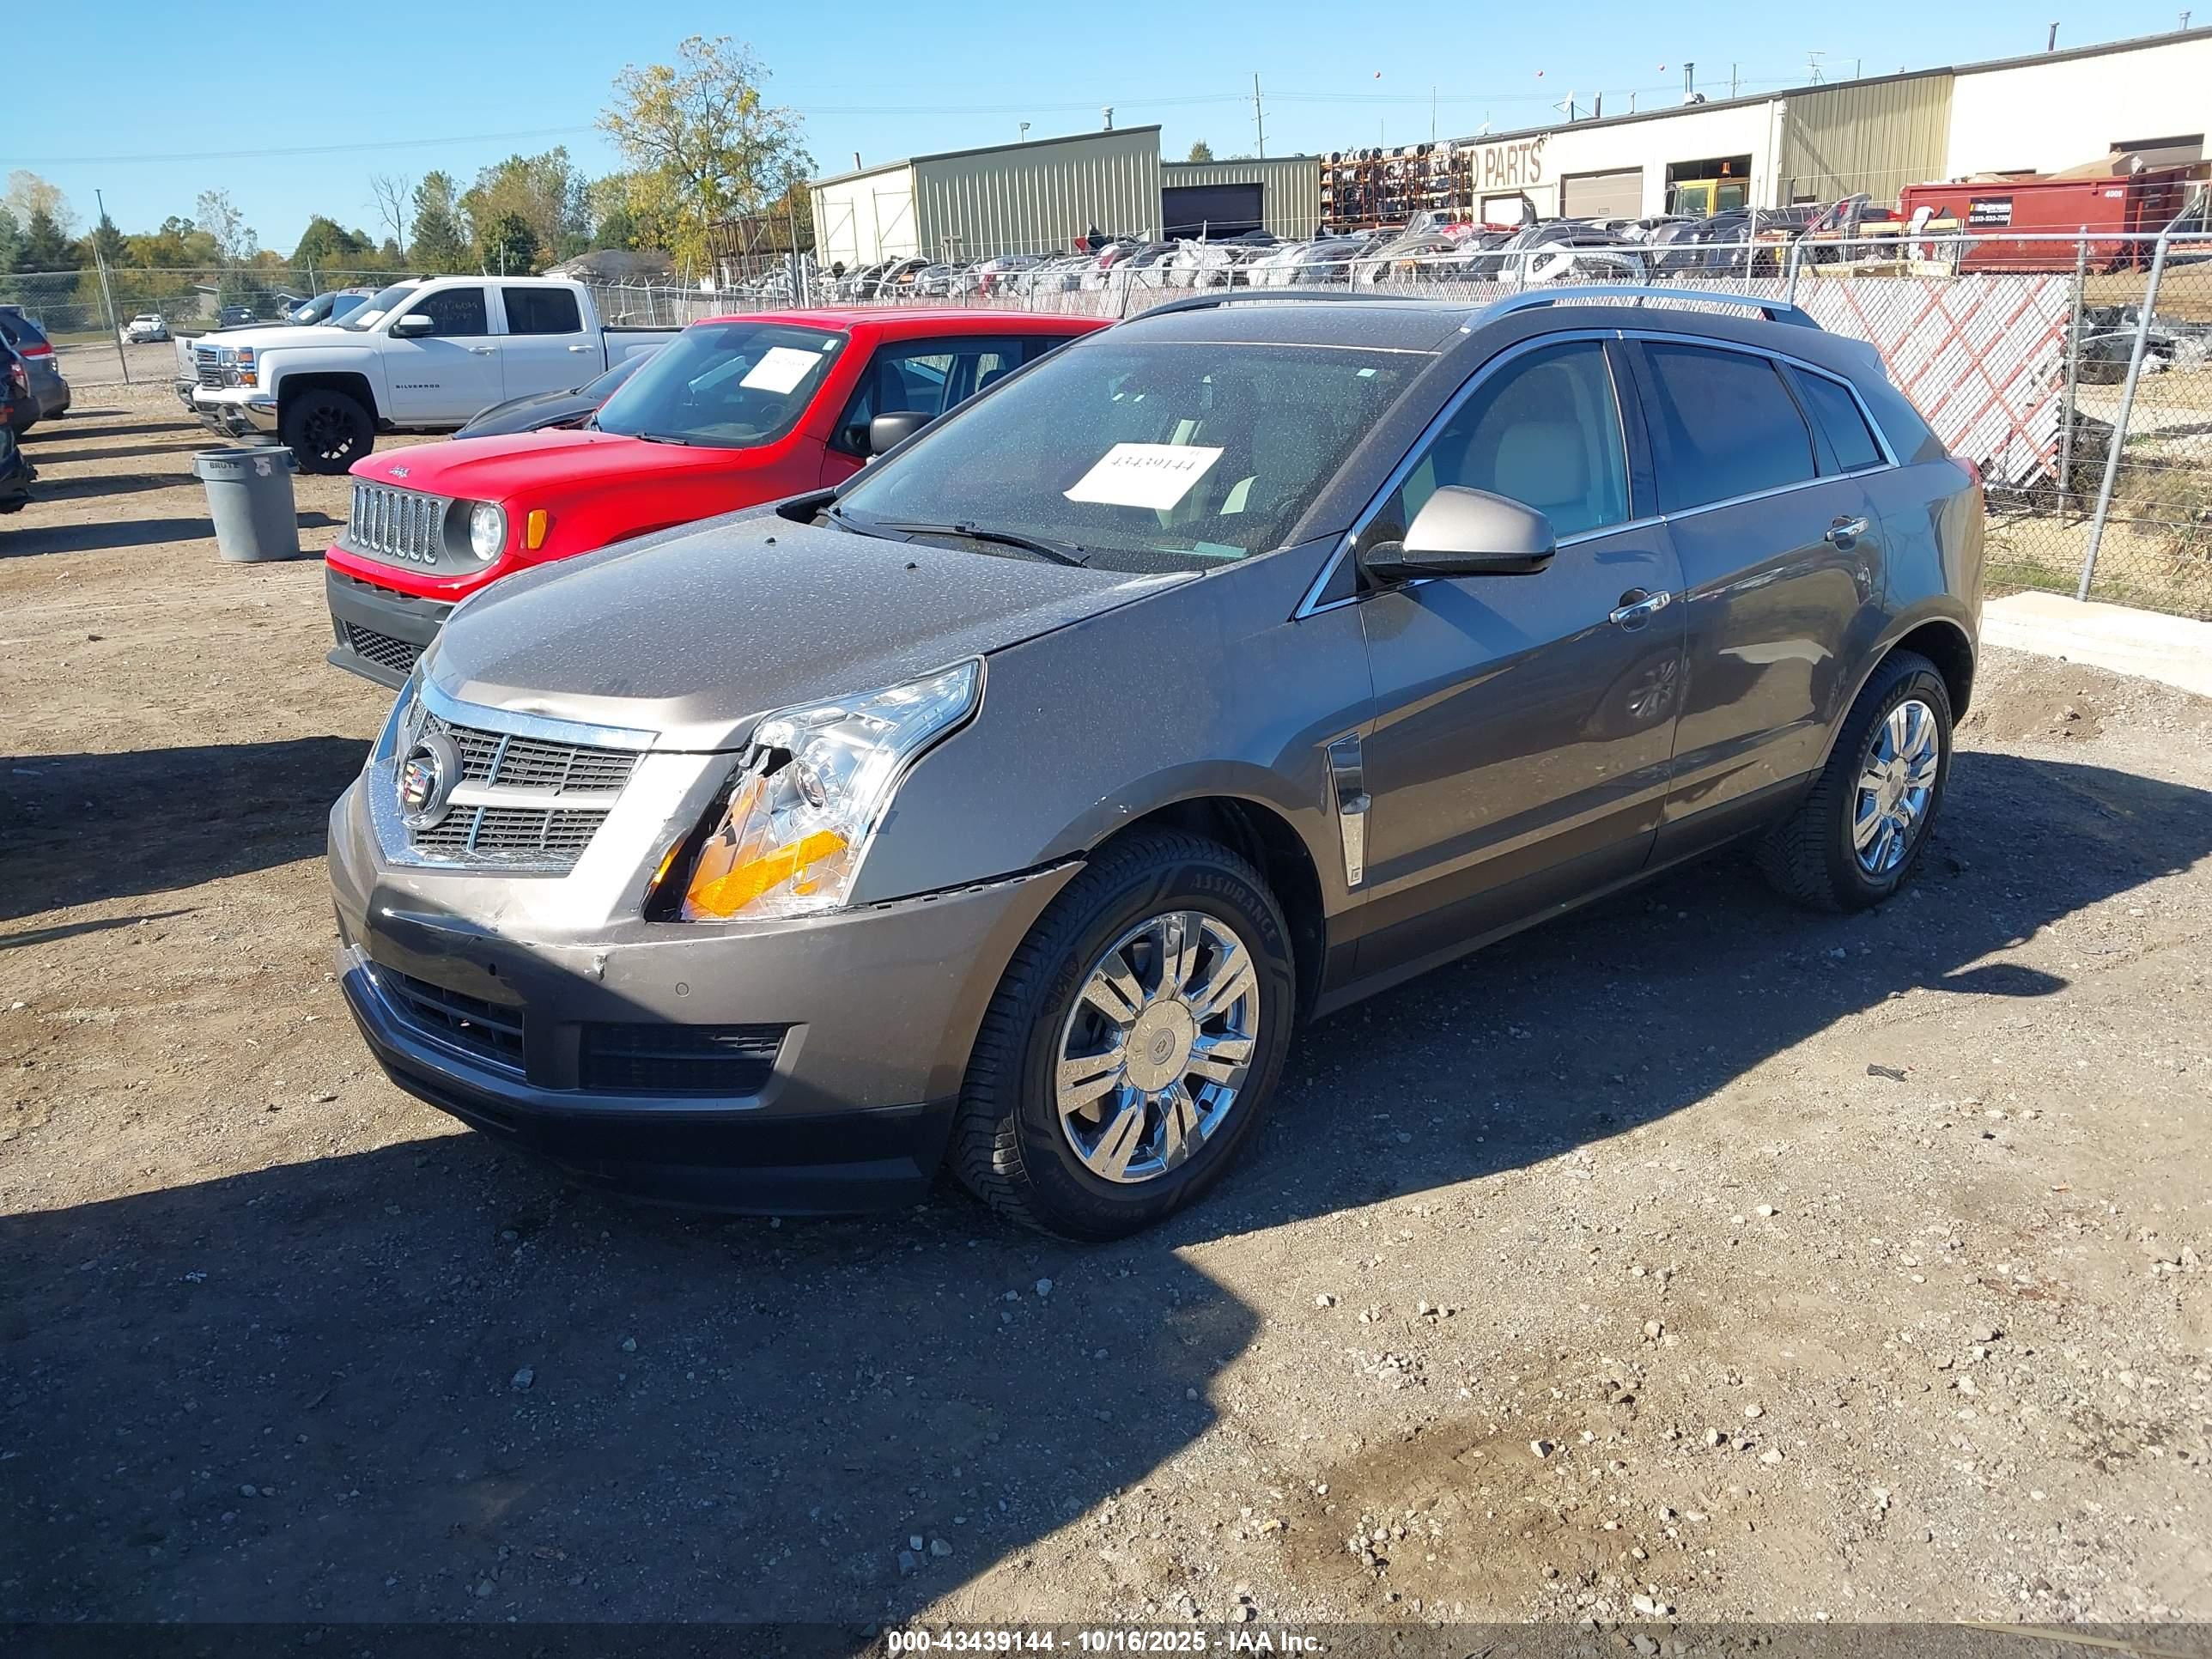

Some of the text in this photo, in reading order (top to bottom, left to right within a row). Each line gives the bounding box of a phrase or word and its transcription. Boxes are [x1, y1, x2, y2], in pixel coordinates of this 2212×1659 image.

[1486, 141, 1541, 187] PARTS
[209, 461, 240, 470] BRUTE
[1189, 872, 1278, 942] ASSURANCE
